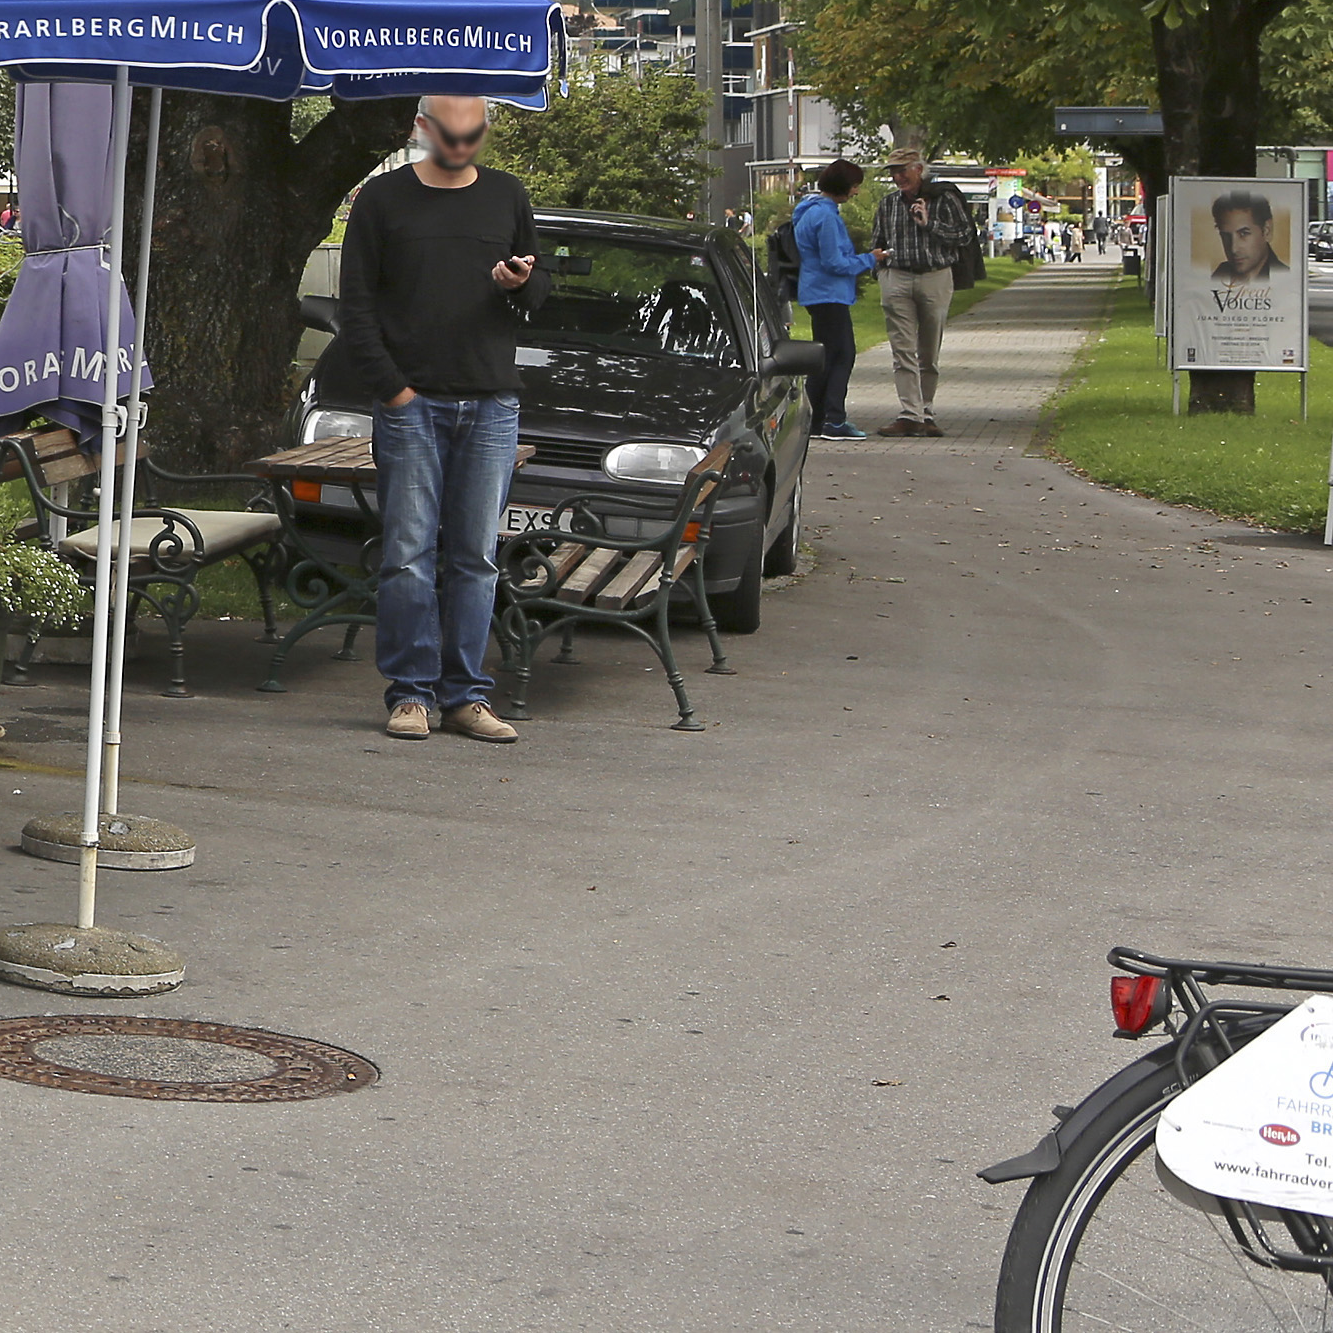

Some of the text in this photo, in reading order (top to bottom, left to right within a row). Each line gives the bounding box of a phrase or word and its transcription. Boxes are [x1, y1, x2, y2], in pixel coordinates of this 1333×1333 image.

[1211, 290, 1272, 313] VOICES
[1277, 1096, 1333, 1118] FAHRR
[1311, 1121, 1333, 1136] BR
[1305, 1153, 1332, 1169] Tel.
[1214, 1160, 1333, 1190] www.fahrradver
